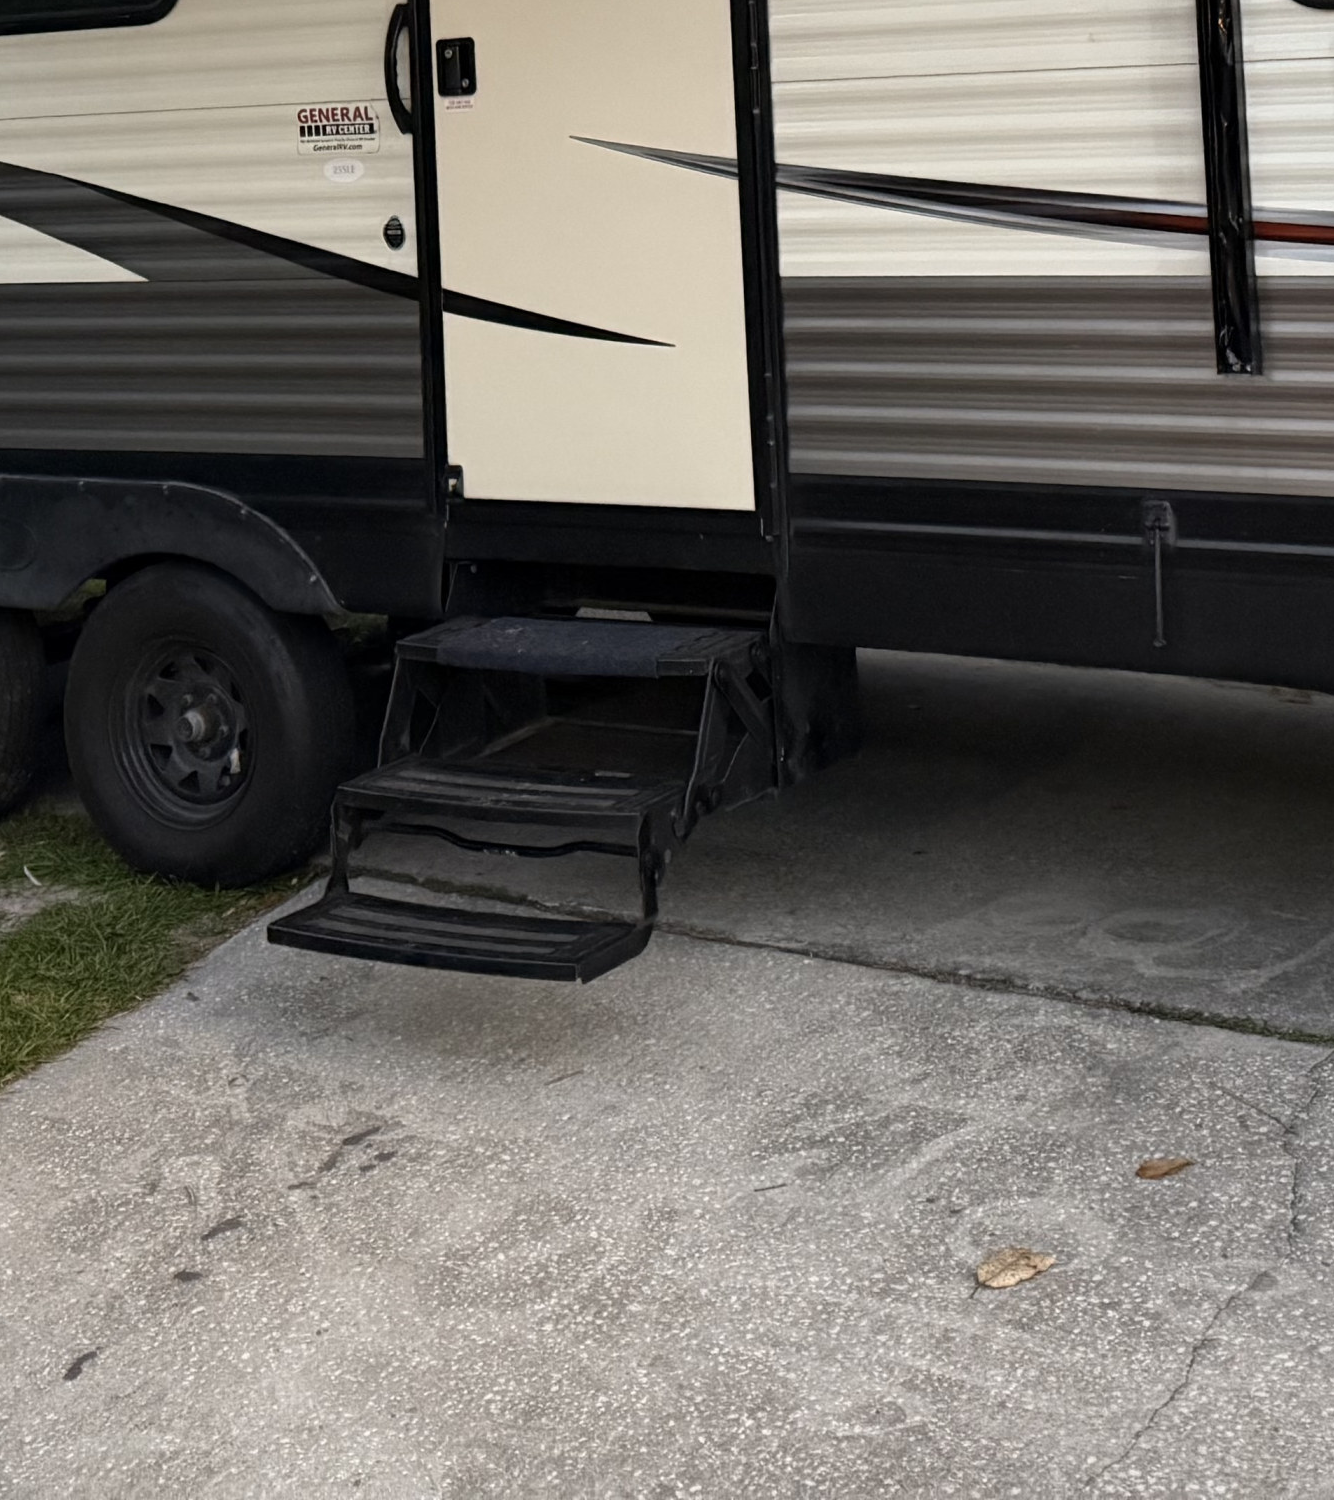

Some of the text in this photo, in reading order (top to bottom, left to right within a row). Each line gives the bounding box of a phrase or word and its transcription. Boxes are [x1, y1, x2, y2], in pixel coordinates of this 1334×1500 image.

[297, 106, 373, 124] GENERAL
[326, 124, 370, 135] RV CENTER
[313, 143, 363, 152] GeneralRV.com
